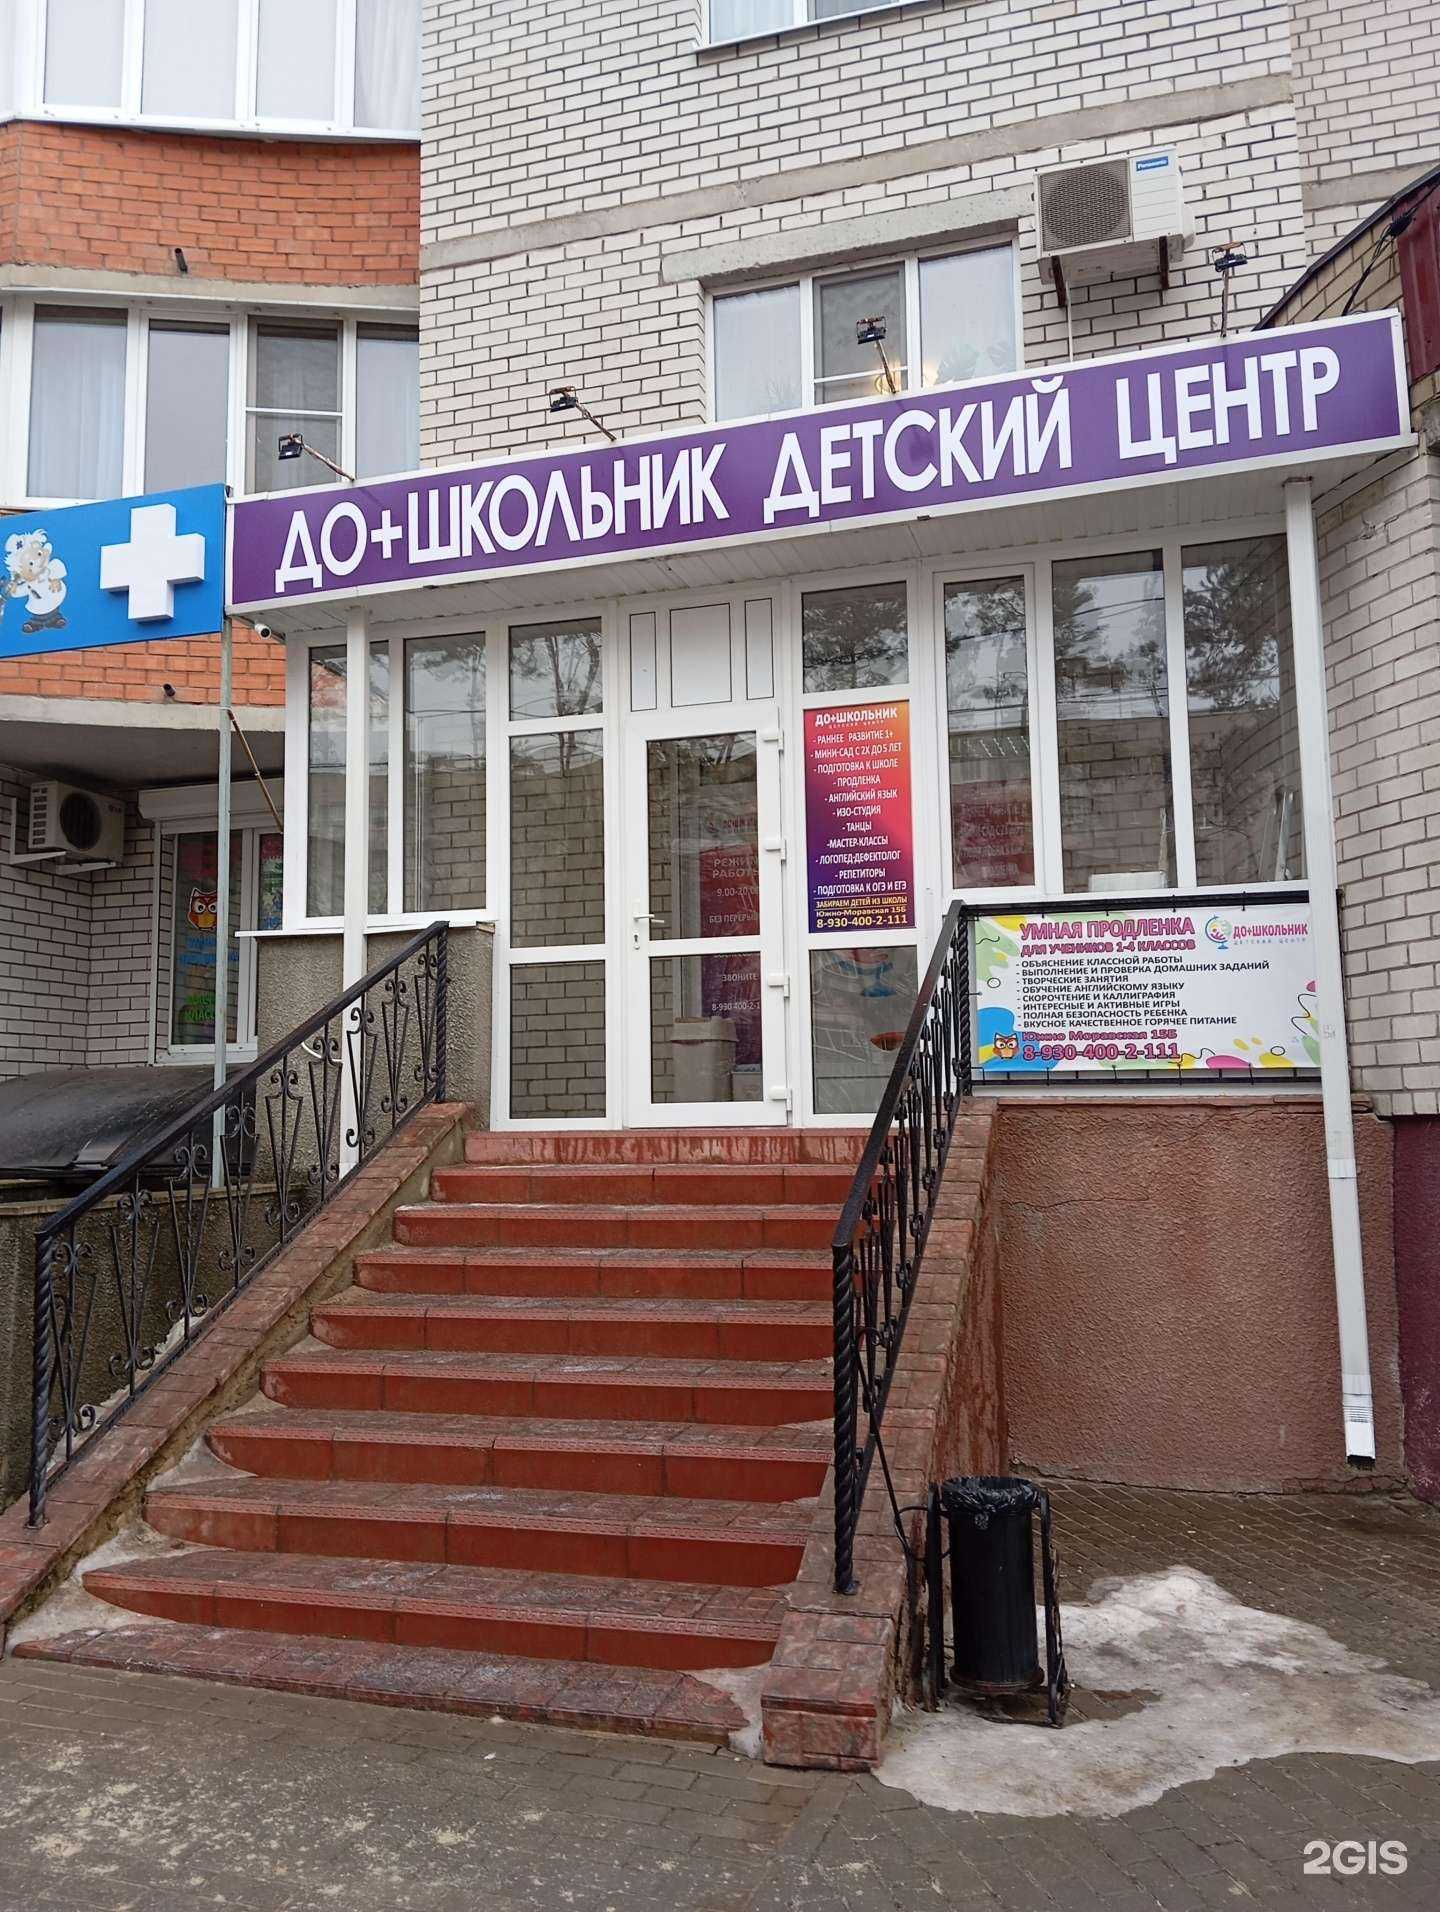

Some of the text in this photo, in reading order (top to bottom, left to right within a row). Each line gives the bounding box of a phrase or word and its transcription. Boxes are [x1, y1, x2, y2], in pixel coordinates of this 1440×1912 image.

[275, 346, 1340, 593] ДО+ШКОЛЬНИК ДЕТСКИЙ ЦЕНТР
[815, 708, 897, 727] ДО+ШКОЛЬНИК
[818, 734, 844, 744] РАННЕЕ
[848, 730, 884, 741] РАЗВИТИЕ
[815, 747, 854, 758] МИНИ-САД
[856, 747, 860, 755] С
[888, 743, 902, 752] ЛЕТ
[818, 759, 898, 775] ПОДГОТОВКА К ШКОЛЕ
[837, 775, 880, 787] ПРОДЛЕНКА
[828, 789, 898, 802] АНГЛИЙСКИЙ ЯЗЫК
[836, 805, 881, 817] ИЗО-СТУДИЯ
[846, 821, 872, 833] ТАНЦЫ
[820, 850, 901, 865] ЛОГОПЕД-ДЕФЕКТОЛОГ
[839, 868, 886, 880] РЕПЕТИТОРЫ
[818, 880, 907, 896] ПОДГОТОВКА К ОГЭ И ЕГЭ
[816, 900, 850, 908] ЗАБИРАЕМ
[850, 897, 870, 908] ДЕТЕЙ
[882, 896, 908, 904] ШКОЛЫ
[816, 908, 889, 918] Южно-Моравская
[816, 914, 908, 928] 8-930-400-2-111
[1020, 917, 1196, 940] УМНАЯ ПРОДЛЕНКА
[1233, 922, 1308, 940] ДО+ШКОЛЬНИК
[1020, 939, 1196, 958] ДЛЯ УЧЕНИКОВ 1-4 КЛАССОВ
[1022, 956, 1182, 968] ОБЪЯСНЕНИЕ КЛАССНОЙ РАБОТЫ
[1022, 968, 1088, 976] ВЫПОЛНЕНИЕ
[1100, 965, 1152, 974] ПРОВЕРКА
[1154, 964, 1217, 974] ДОМАШНИХ
[1220, 961, 1270, 970] ЗАДАНИЙ
[1022, 975, 1128, 985] ТВОРЧЕСКИЕ ЗАНЯТИЯ
[1022, 982, 1184, 994] ОБУЧЕНИЕ АНГЛИЙСКОМУ ЯЗЫКУ
[1022, 994, 1090, 1002] СКОРОЧТЕНИЕ
[1102, 991, 1176, 1000] КАЛЛИГРАФИЯ
[1023, 1002, 1084, 1010] ИНТЕРЕСНЫЕ
[1097, 1000, 1150, 1009] АКТИВНЫЕ
[1153, 1000, 1180, 1008] ИГРЫ
[1023, 1008, 1188, 1020] ПОЛНАЯ БЕЗОПАСНОСТЬ РЕБЕНКА
[1024, 1016, 1237, 1028] ВКУСНОЕ КАЧЕСТВЕННОЕ ГОРЯЧЕЕ ПИТАНИЕ
[1022, 1031, 1066, 1041] Южно
[1068, 1030, 1148, 1042] Моравская
[1022, 1042, 1180, 1060] 8-930-400-2-111
